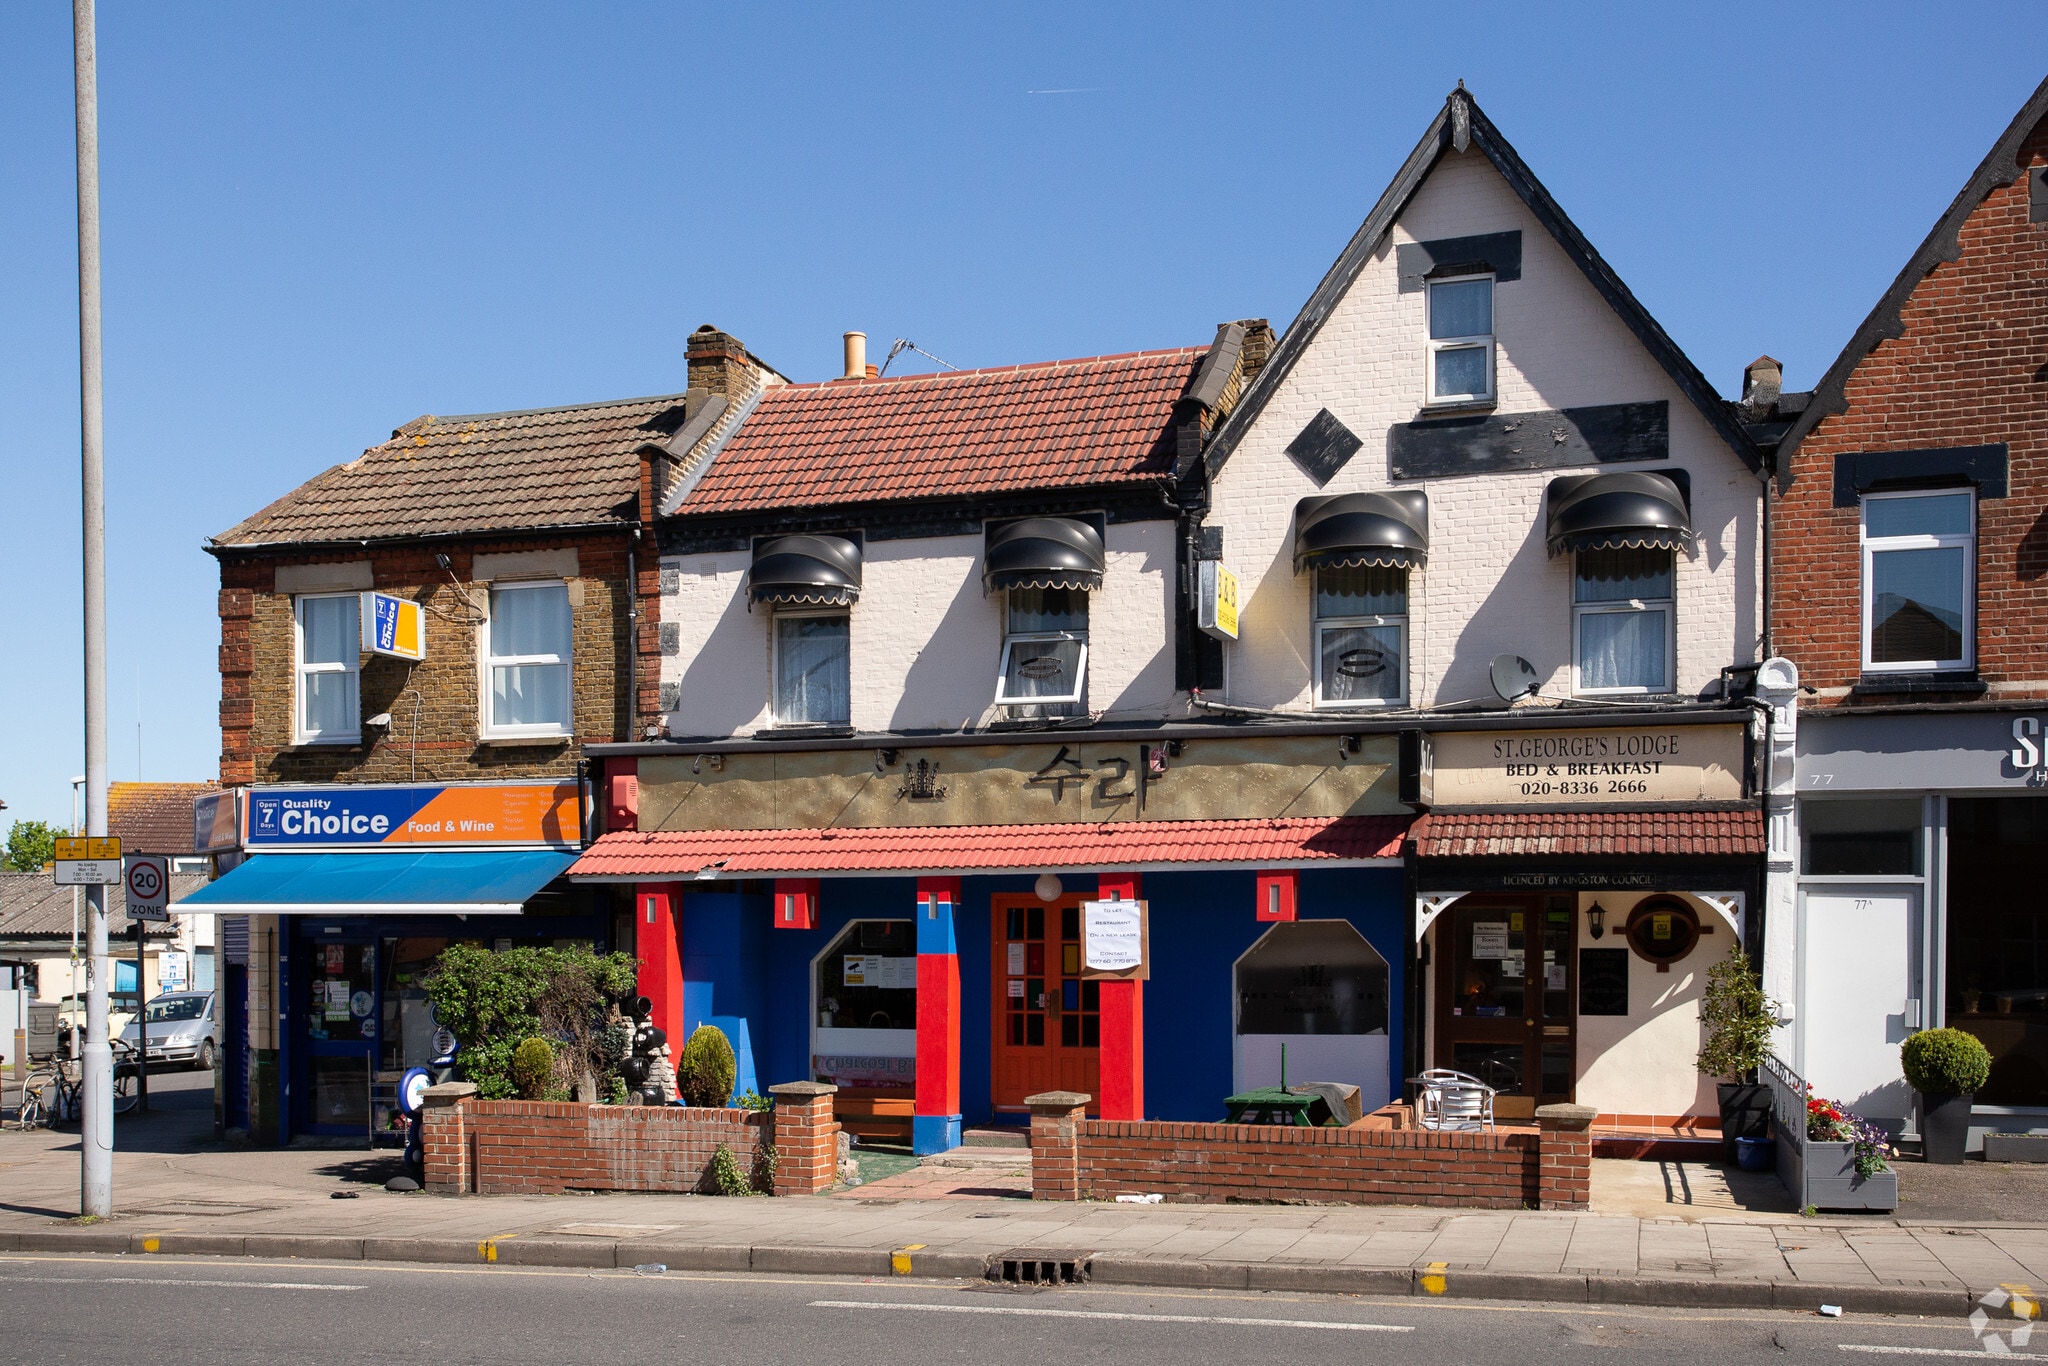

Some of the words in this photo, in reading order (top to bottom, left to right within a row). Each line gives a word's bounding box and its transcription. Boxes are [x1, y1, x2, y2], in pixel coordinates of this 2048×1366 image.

[384, 602, 396, 649] Choice
[1494, 736, 1608, 759] ST.GEORGE'S
[1616, 735, 1679, 756] LODGE
[2012, 717, 2048, 768] S
[1506, 763, 1538, 777] BED
[1546, 763, 1559, 776] &
[1567, 761, 1662, 776] BREAKFAST
[1029, 745, 1163, 812] 수라
[1810, 774, 1834, 785] 77
[1521, 781, 1599, 795] 020-8336
[1608, 780, 1647, 793] 2666
[259, 801, 277, 809] Open
[282, 799, 331, 810] Quality
[262, 809, 274, 823] 7
[281, 809, 389, 835] Choice
[407, 821, 440, 833] Food
[444, 821, 455, 832] &
[460, 820, 495, 832] Wine
[134, 873, 157, 888] 20
[1503, 875, 1545, 885] LICENCED
[1548, 875, 1559, 885] BY
[1562, 875, 1608, 885] KINGSTON
[1611, 874, 1652, 885] COUNCIL
[131, 904, 162, 915] ZONE
